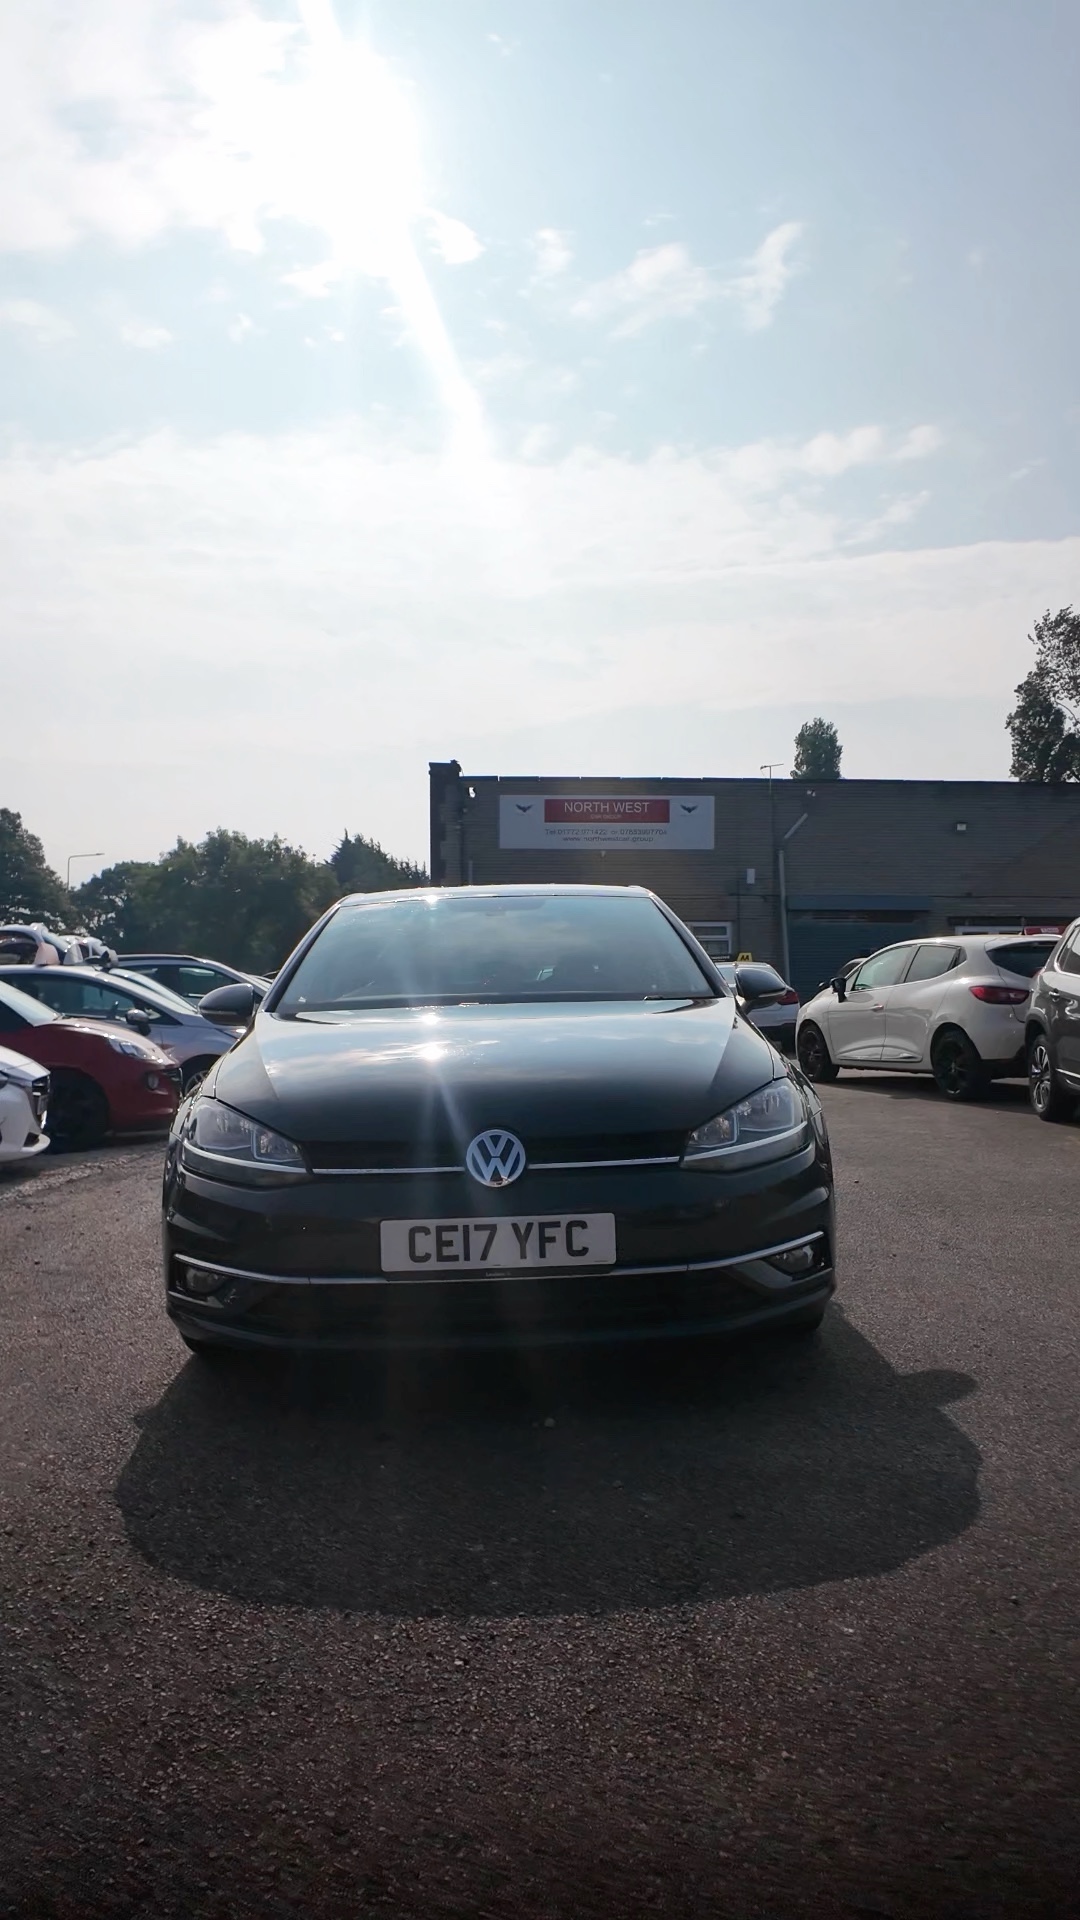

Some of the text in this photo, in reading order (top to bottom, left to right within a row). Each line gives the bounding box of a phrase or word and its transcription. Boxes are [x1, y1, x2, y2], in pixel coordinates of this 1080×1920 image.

[564, 802, 650, 813] NORTH WEST
[466, 1129, 526, 1187] VW
[408, 1219, 590, 1263] CE17 YFC
